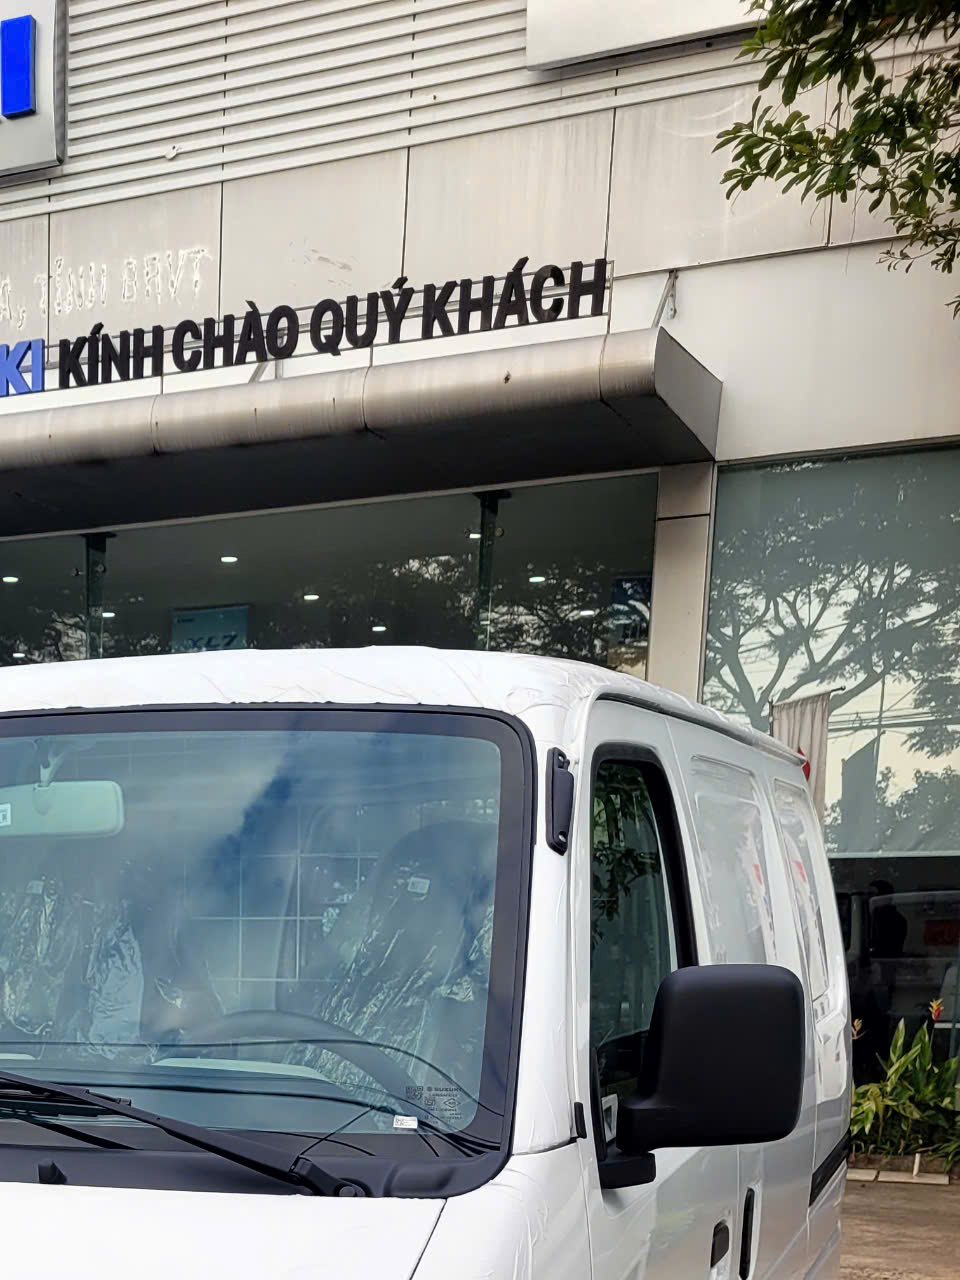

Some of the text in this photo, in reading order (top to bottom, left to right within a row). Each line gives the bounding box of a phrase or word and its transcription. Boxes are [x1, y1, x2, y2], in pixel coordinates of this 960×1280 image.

[58, 322, 165, 389] KÍNH
[172, 300, 300, 373] CHÀO
[310, 276, 414, 356] QUÝ
[421, 256, 607, 339] KHÁCH
